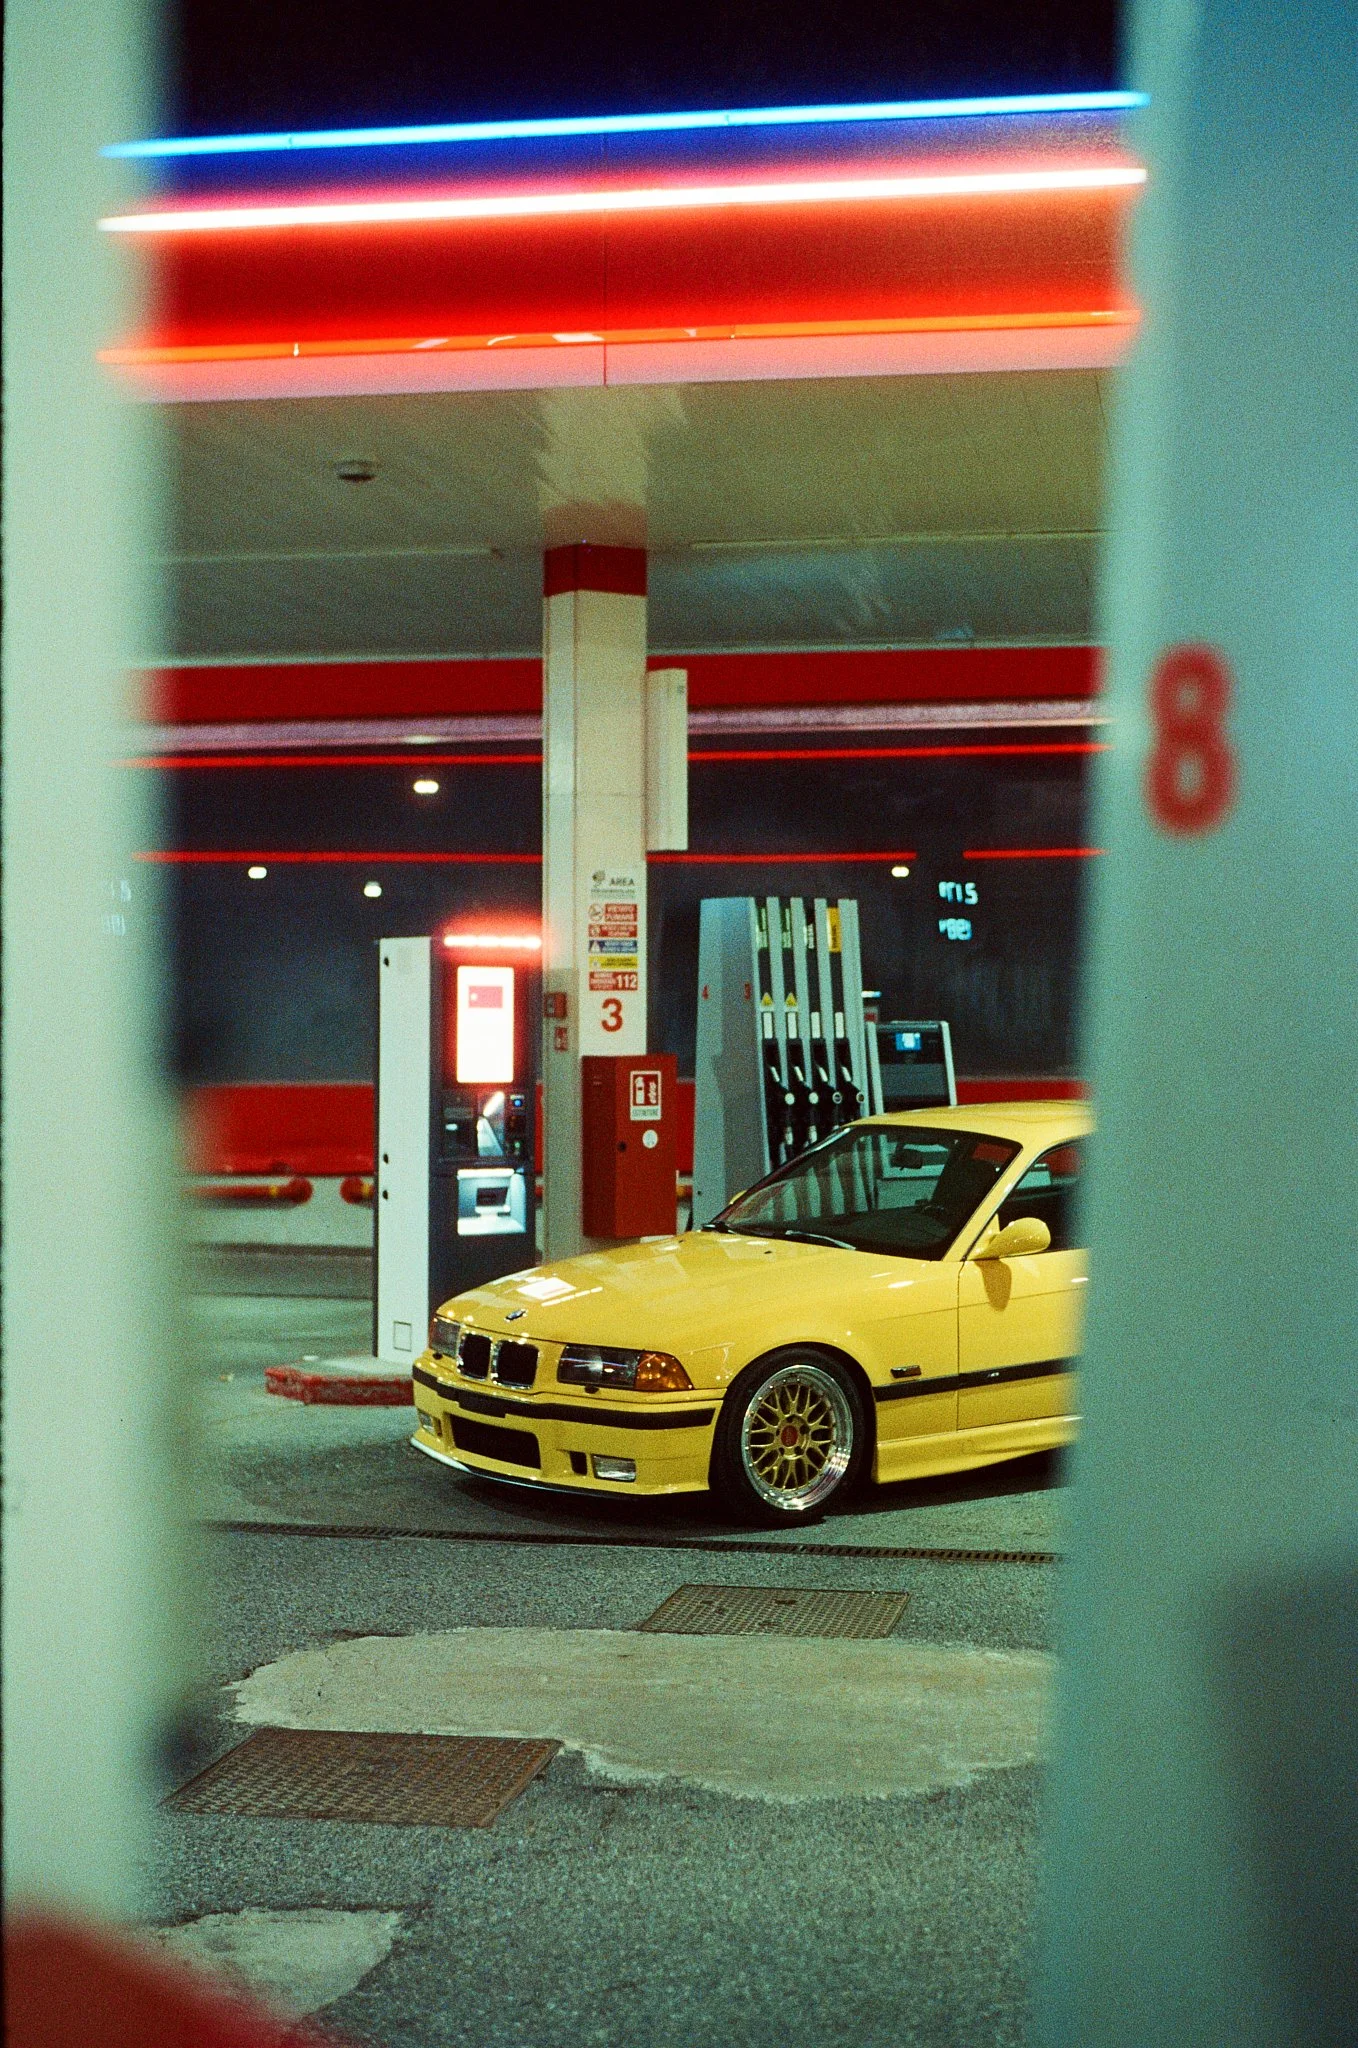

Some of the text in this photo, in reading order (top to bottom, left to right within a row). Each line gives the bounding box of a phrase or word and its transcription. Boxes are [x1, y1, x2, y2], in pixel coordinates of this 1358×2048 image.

[1146, 643, 1234, 835] 8
[609, 877, 635, 887] AREA
[616, 974, 637, 988] 112
[601, 997, 623, 1033] 3
